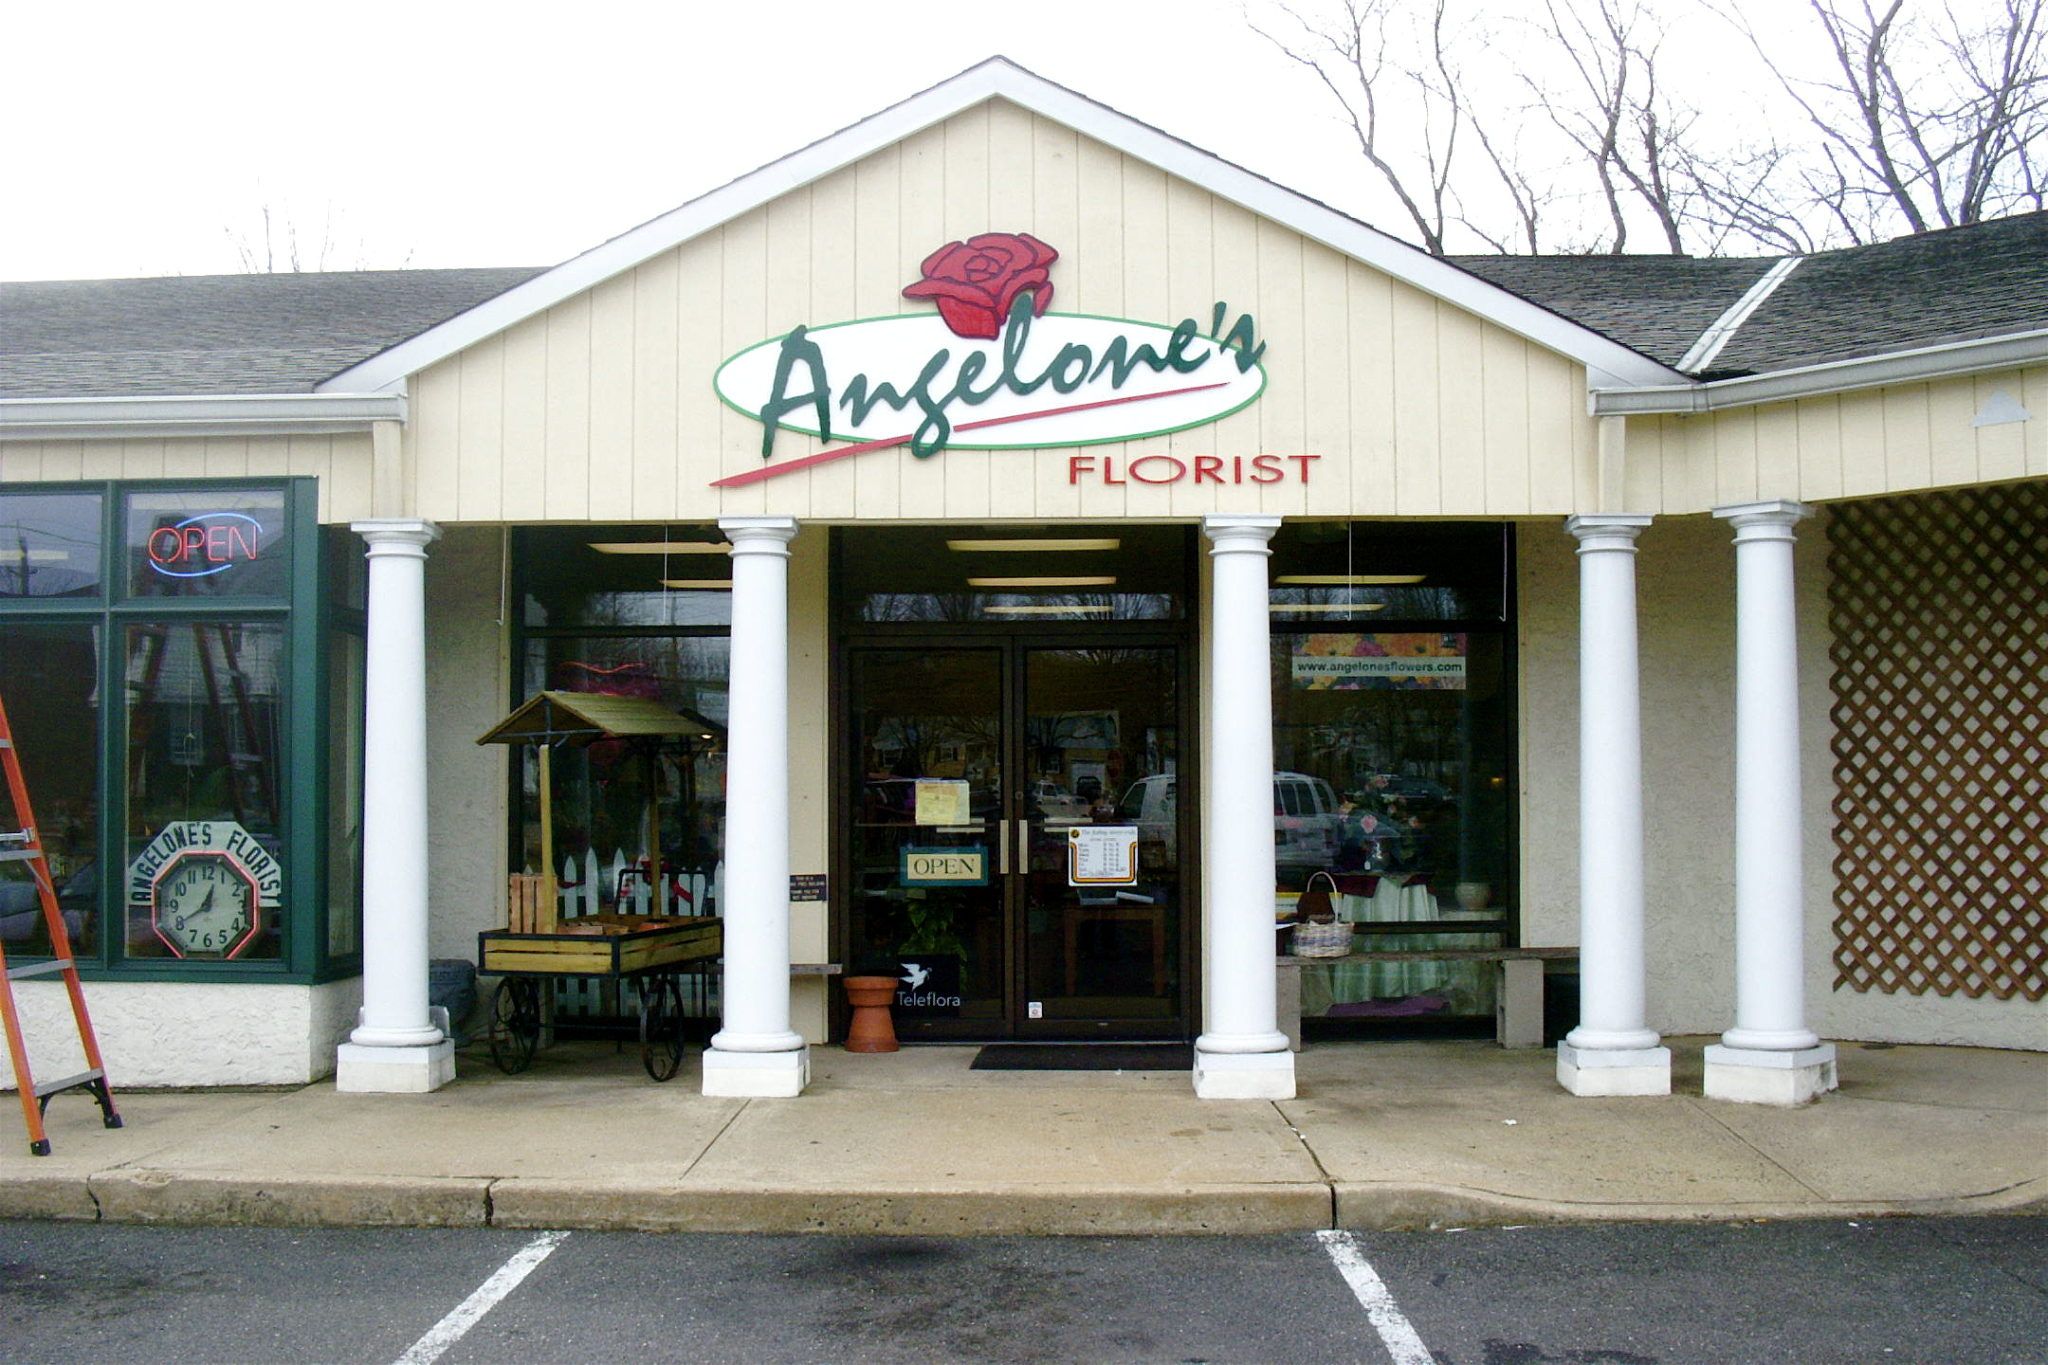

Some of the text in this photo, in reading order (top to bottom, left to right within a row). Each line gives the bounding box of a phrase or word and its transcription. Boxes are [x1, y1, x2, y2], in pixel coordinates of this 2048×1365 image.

[761, 294, 1267, 458] Angelone's
[1069, 455, 1321, 485] FLORIST
[148, 524, 258, 563] OPEN
[1298, 661, 1462, 673] www.angelonesflowers.com
[131, 822, 281, 903] ANGELONE'S FLORIST
[913, 858, 975, 875] OPEN
[897, 992, 961, 1007] Teleflora
